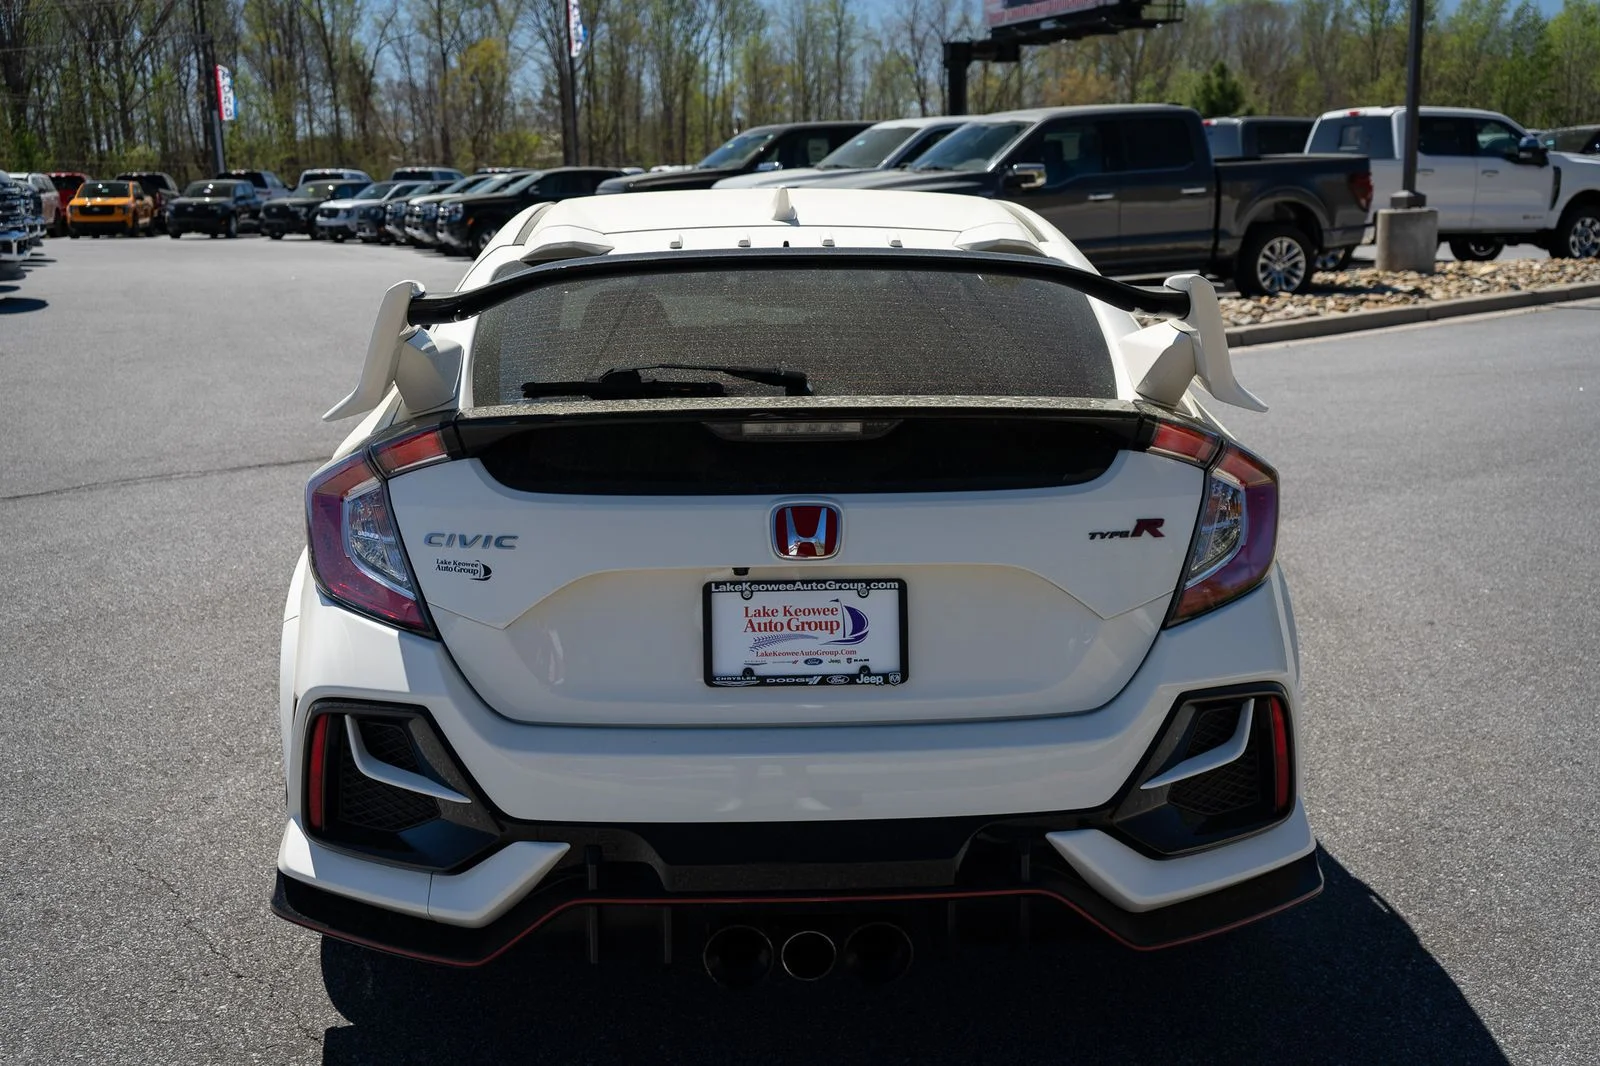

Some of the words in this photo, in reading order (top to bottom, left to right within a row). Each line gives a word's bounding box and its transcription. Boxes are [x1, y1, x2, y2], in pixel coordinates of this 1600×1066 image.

[1088, 530, 1130, 540] TYPE
[1130, 518, 1165, 537] R
[423, 532, 519, 550] CIVIC
[454, 566, 479, 575] Group
[711, 581, 899, 592] LakeKeoweeAutoGroup.com
[744, 606, 779, 618] Lake
[782, 605, 839, 617] Keowee
[744, 618, 785, 632] Auto
[786, 617, 841, 635] Group
[756, 648, 857, 658] LakeKeoweeAutoGroup.Com
[829, 676, 848, 684] Ford
[856, 674, 884, 686] Jeep
